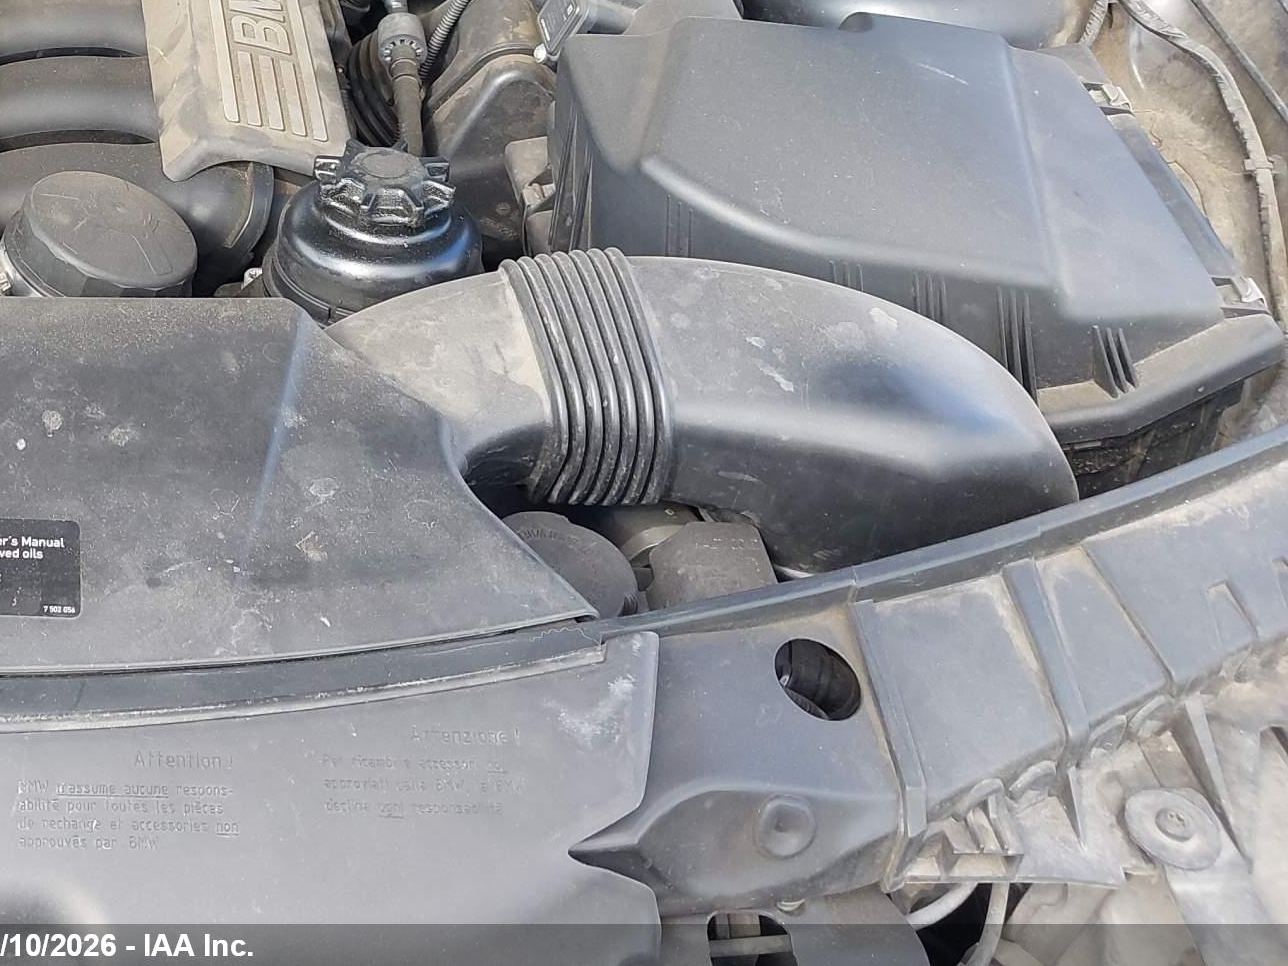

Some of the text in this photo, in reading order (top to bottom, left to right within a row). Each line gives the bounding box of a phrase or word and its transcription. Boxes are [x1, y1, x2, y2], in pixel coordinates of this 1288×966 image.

[22, 537, 64, 548] Manual
[23, 549, 43, 559] oils
[135, 750, 221, 769] Attention
[66, 802, 96, 815] pour
[216, 822, 240, 836] non
